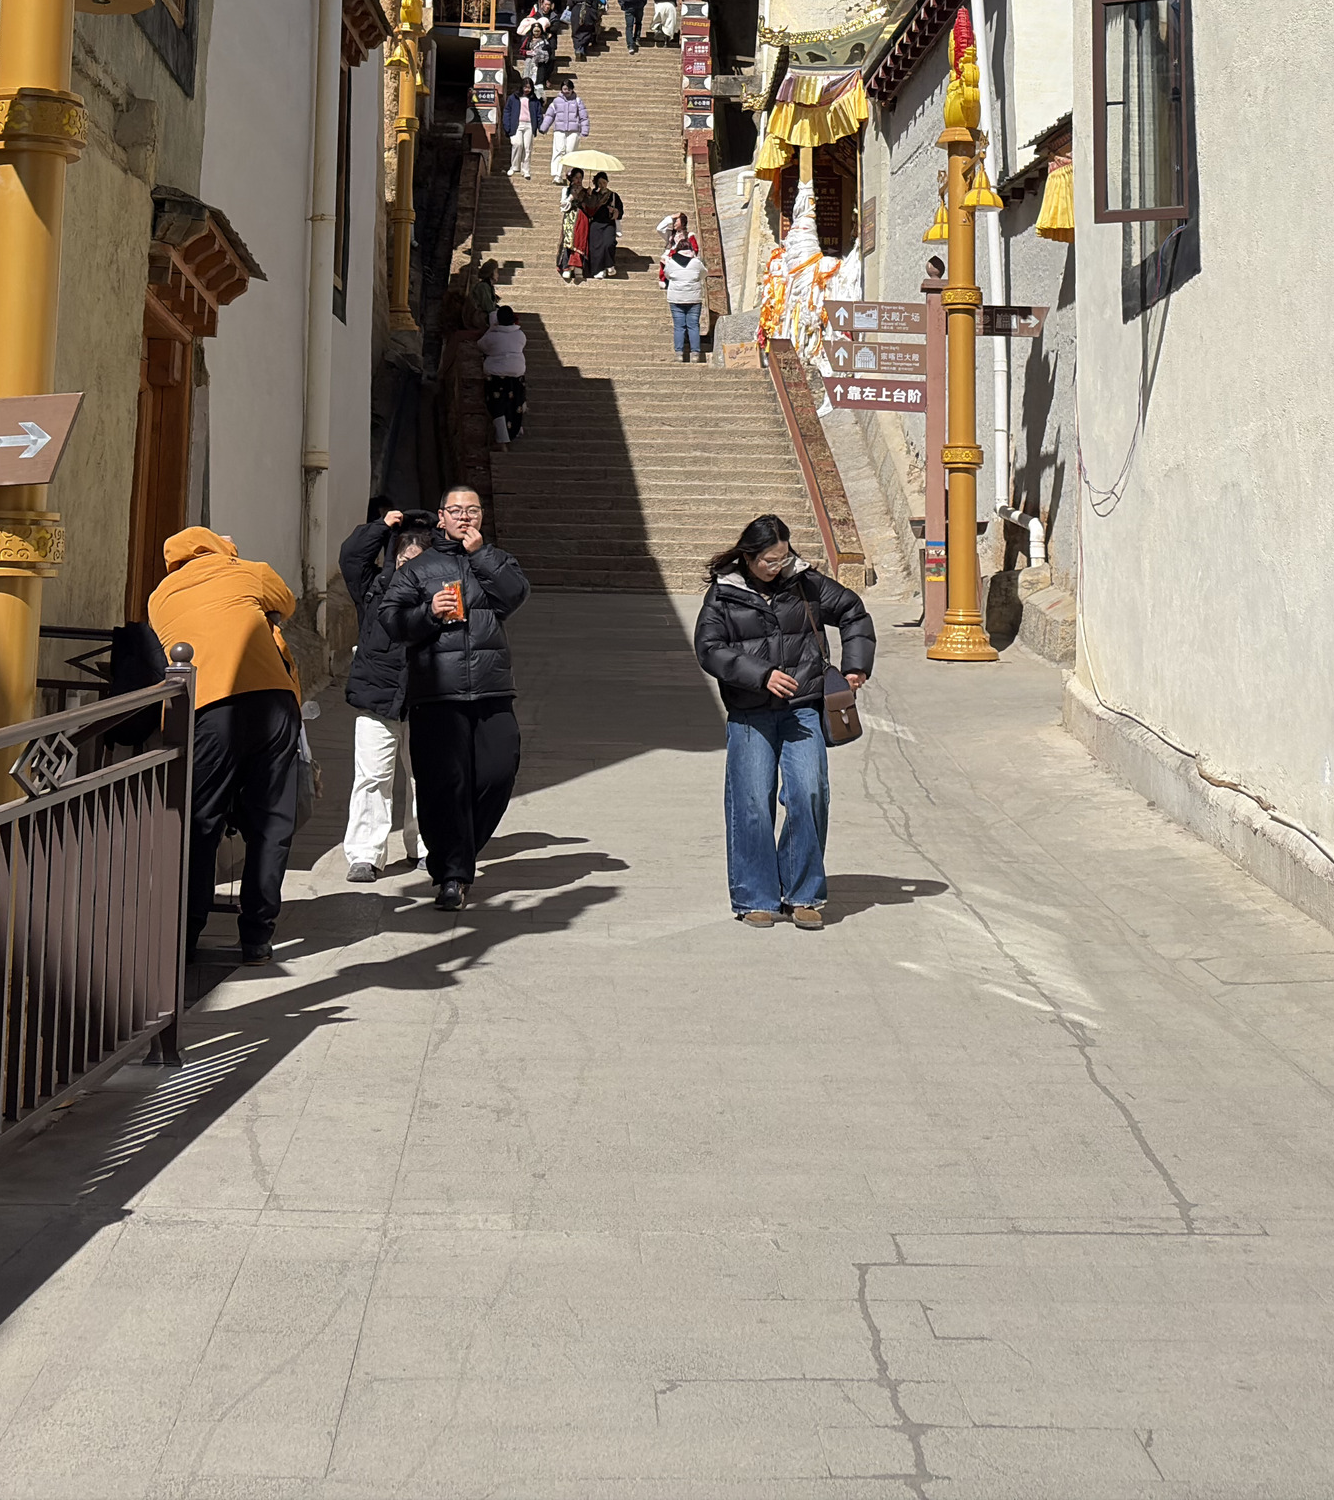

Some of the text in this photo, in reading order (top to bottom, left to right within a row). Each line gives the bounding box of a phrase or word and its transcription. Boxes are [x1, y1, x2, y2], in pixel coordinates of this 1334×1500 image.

[880, 310, 920, 322] 大殿广场
[847, 385, 922, 404] 靠左上台阶
